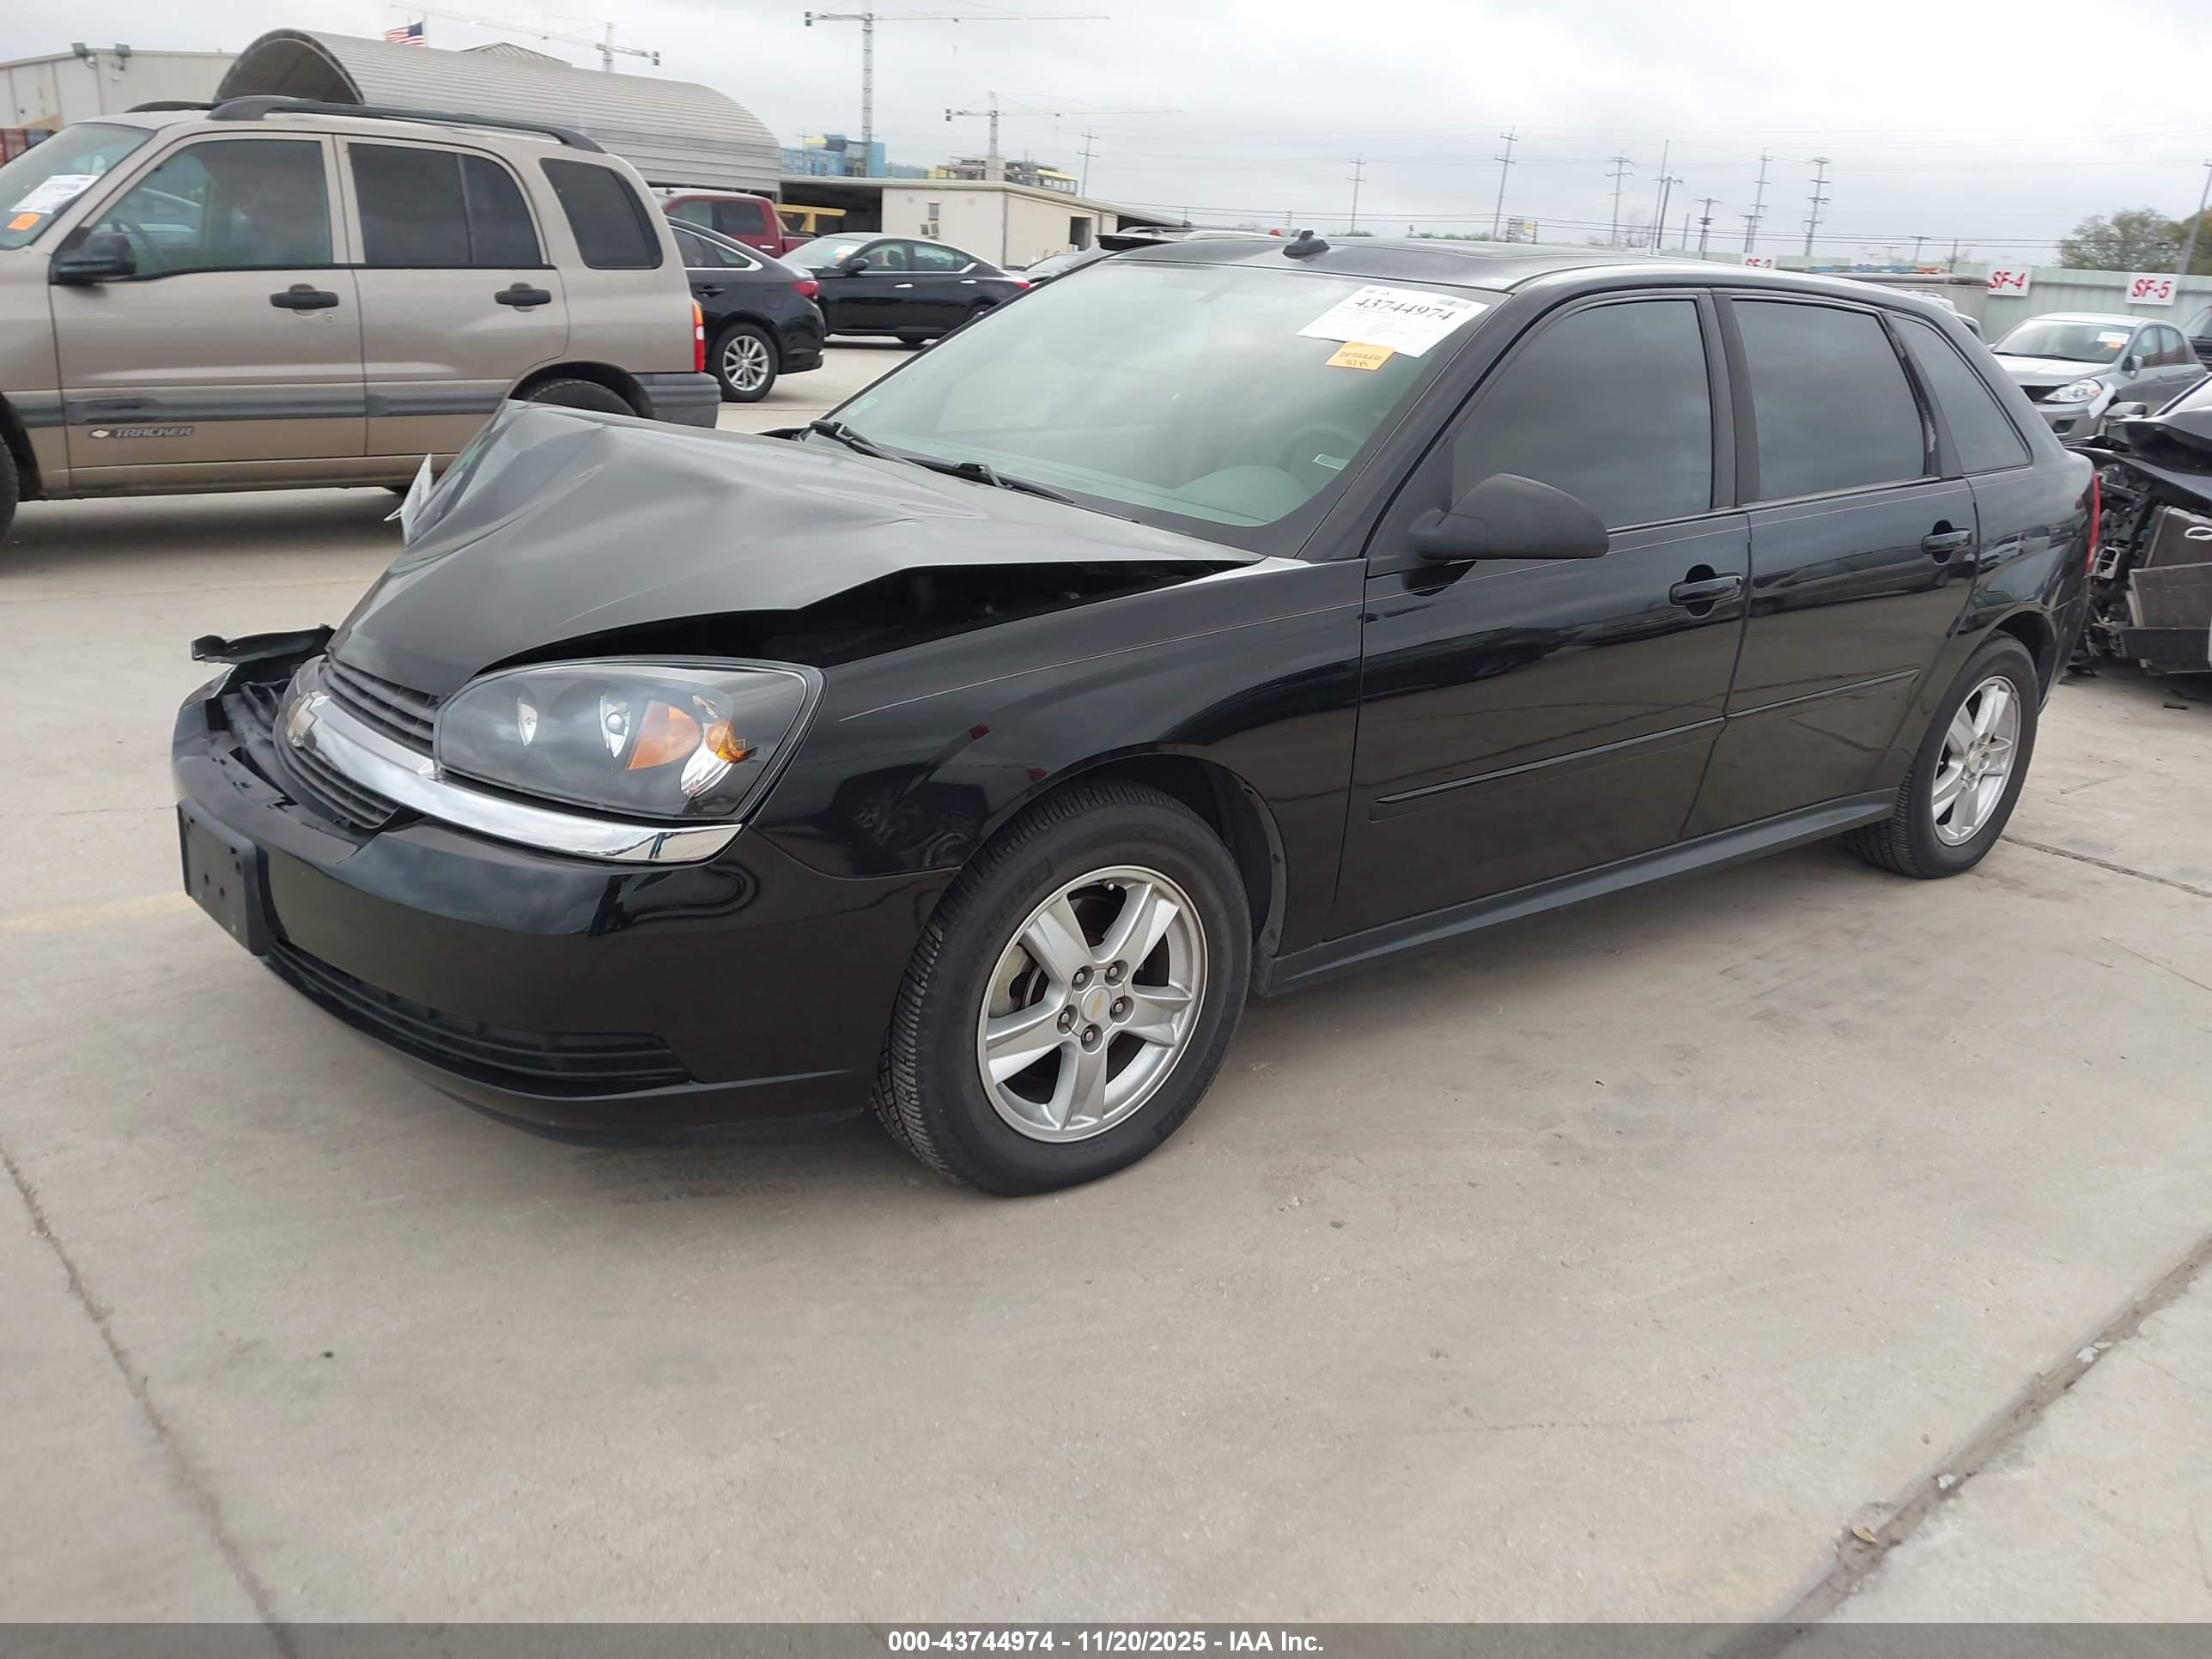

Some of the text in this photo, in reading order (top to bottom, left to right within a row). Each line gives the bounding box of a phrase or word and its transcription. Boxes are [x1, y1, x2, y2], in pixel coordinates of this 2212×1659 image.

[1988, 270, 2027, 289] SF-4
[2131, 278, 2172, 299] SF-5
[1354, 297, 1457, 321] 43744974
[115, 427, 193, 438] TRACKER
